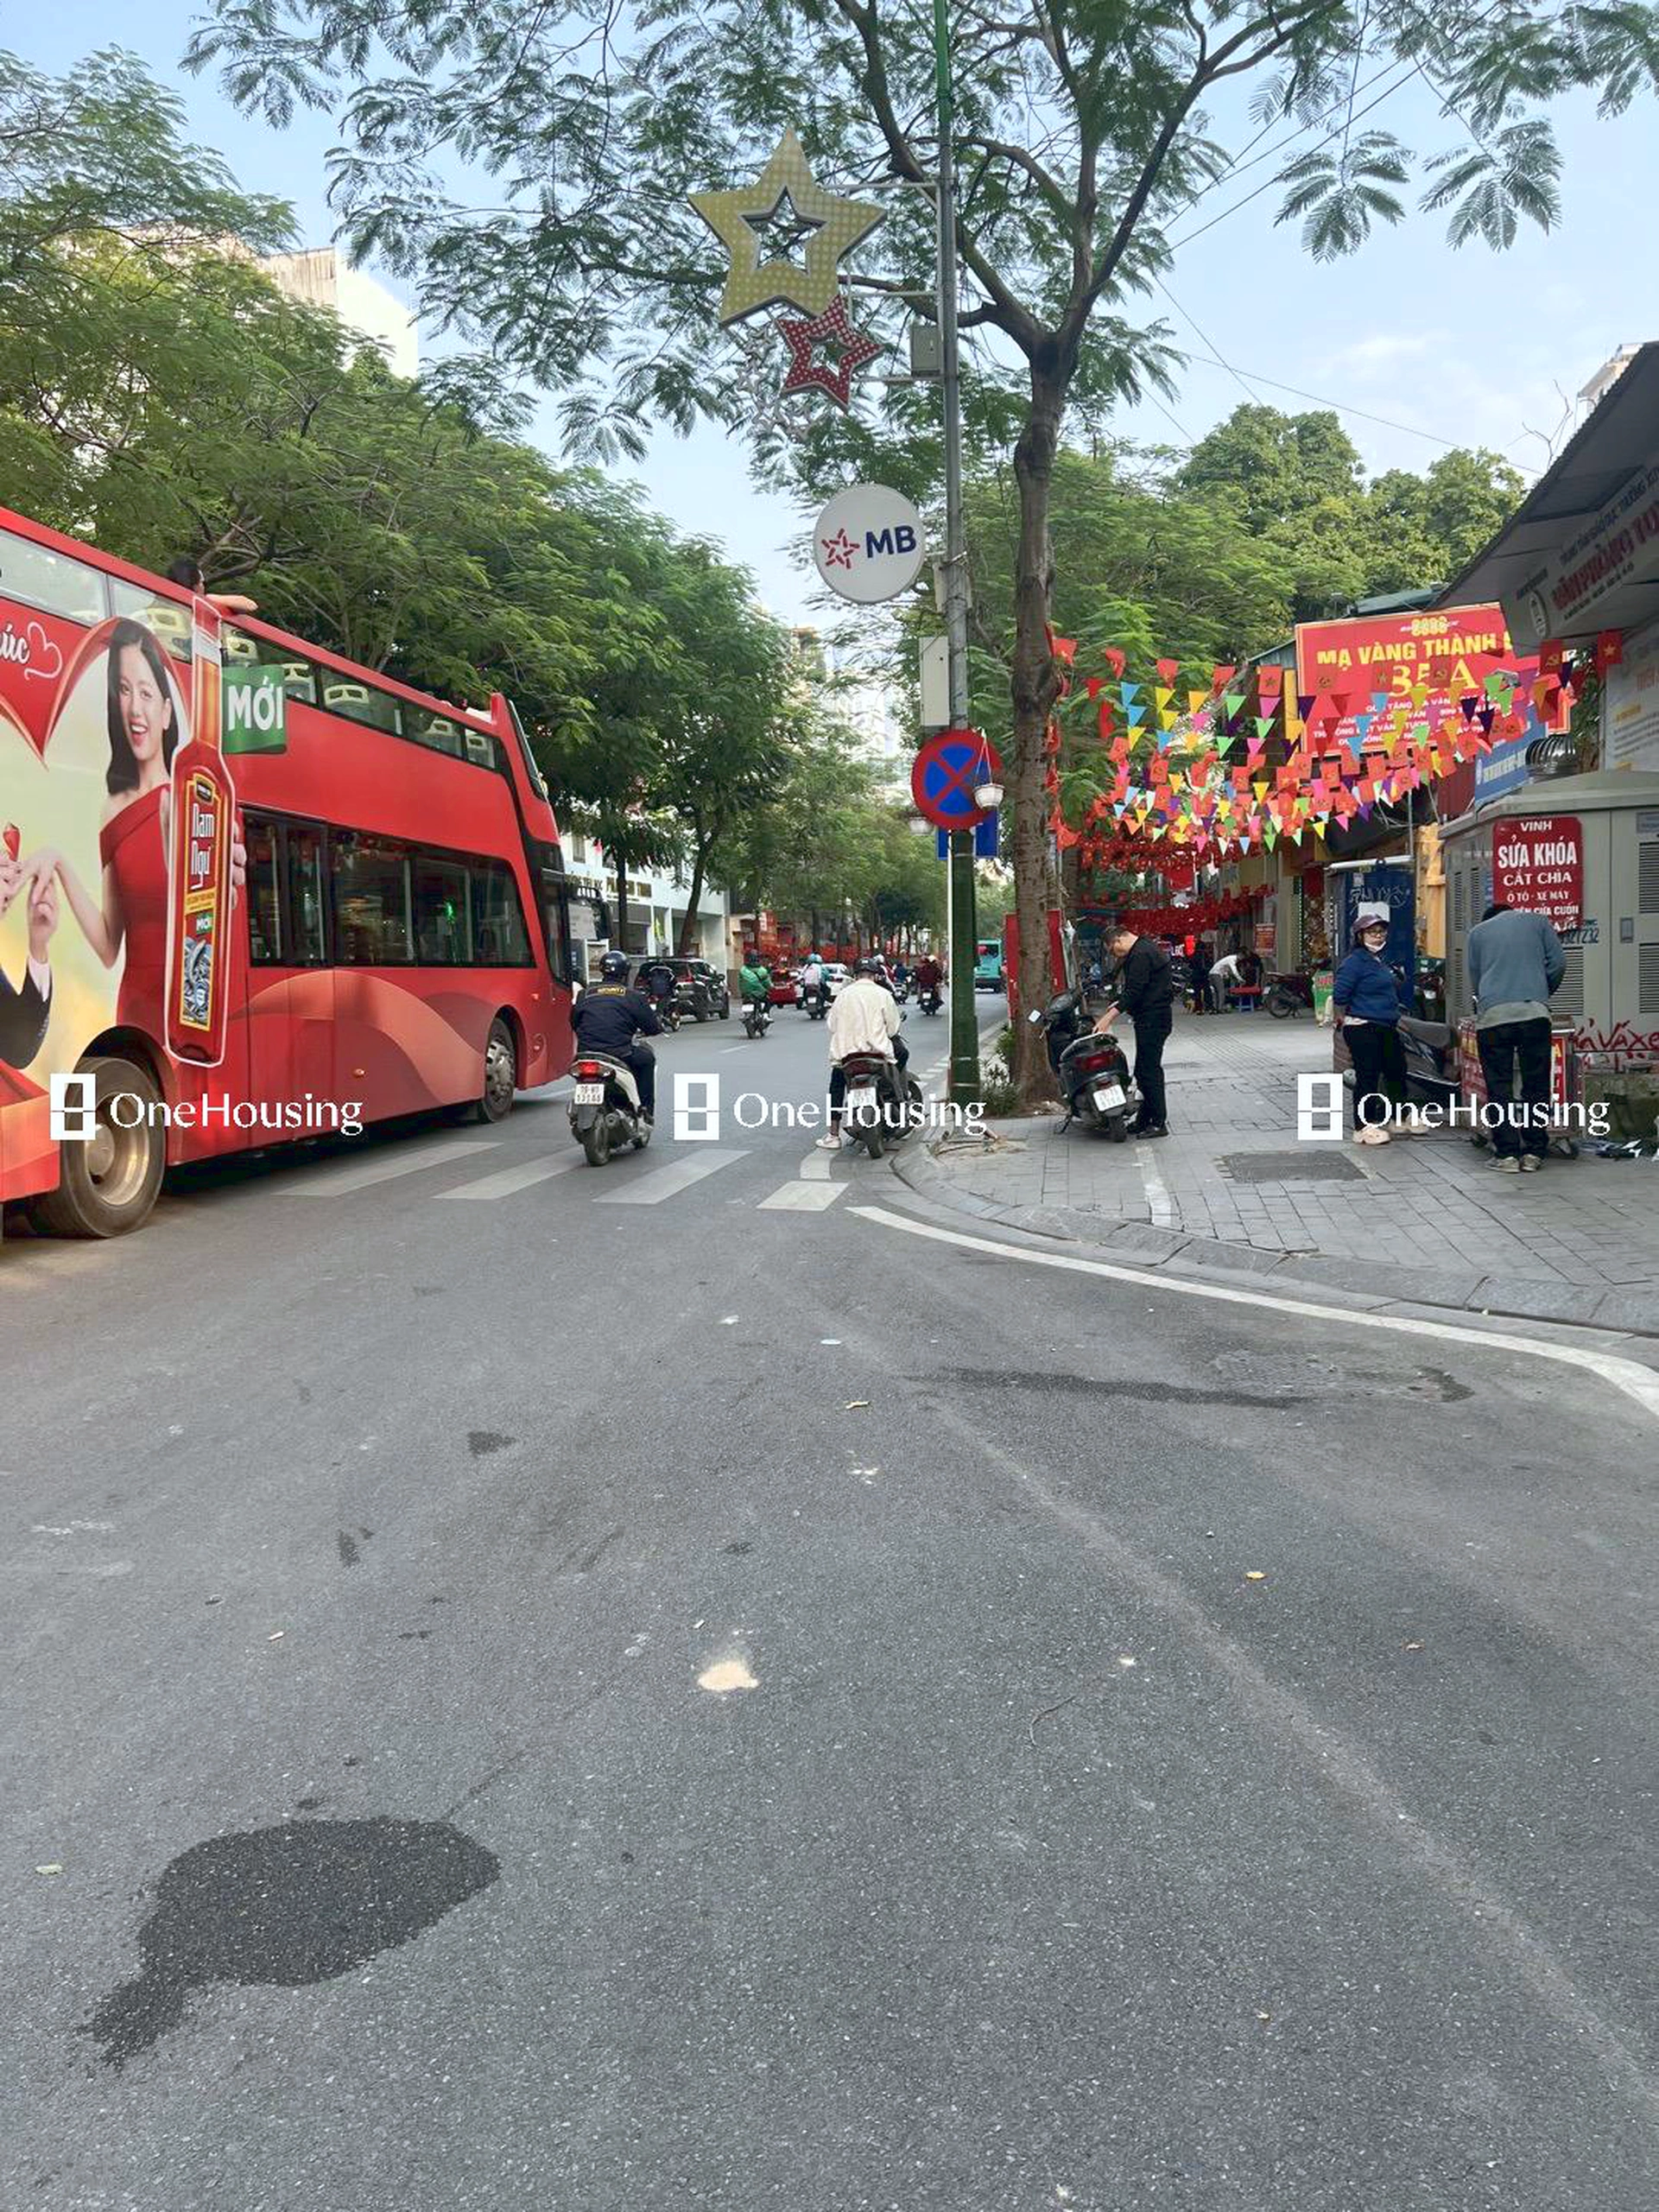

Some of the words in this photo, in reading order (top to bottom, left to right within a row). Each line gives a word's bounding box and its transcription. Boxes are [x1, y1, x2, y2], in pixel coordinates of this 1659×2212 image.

[865, 524, 917, 559] MB
[0, 624, 30, 664] úc
[1316, 650, 1352, 672] MẠ
[1358, 639, 1417, 665] VÀNG
[1421, 631, 1497, 658] THÀNH
[227, 675, 284, 732] MỚI
[193, 802, 214, 838] Nam
[1520, 821, 1553, 832] VINH
[1498, 834, 1529, 869] SỬA
[1534, 835, 1578, 867] KHÓA
[1503, 869, 1533, 886] CẮT
[1536, 870, 1573, 884] CHÌA
